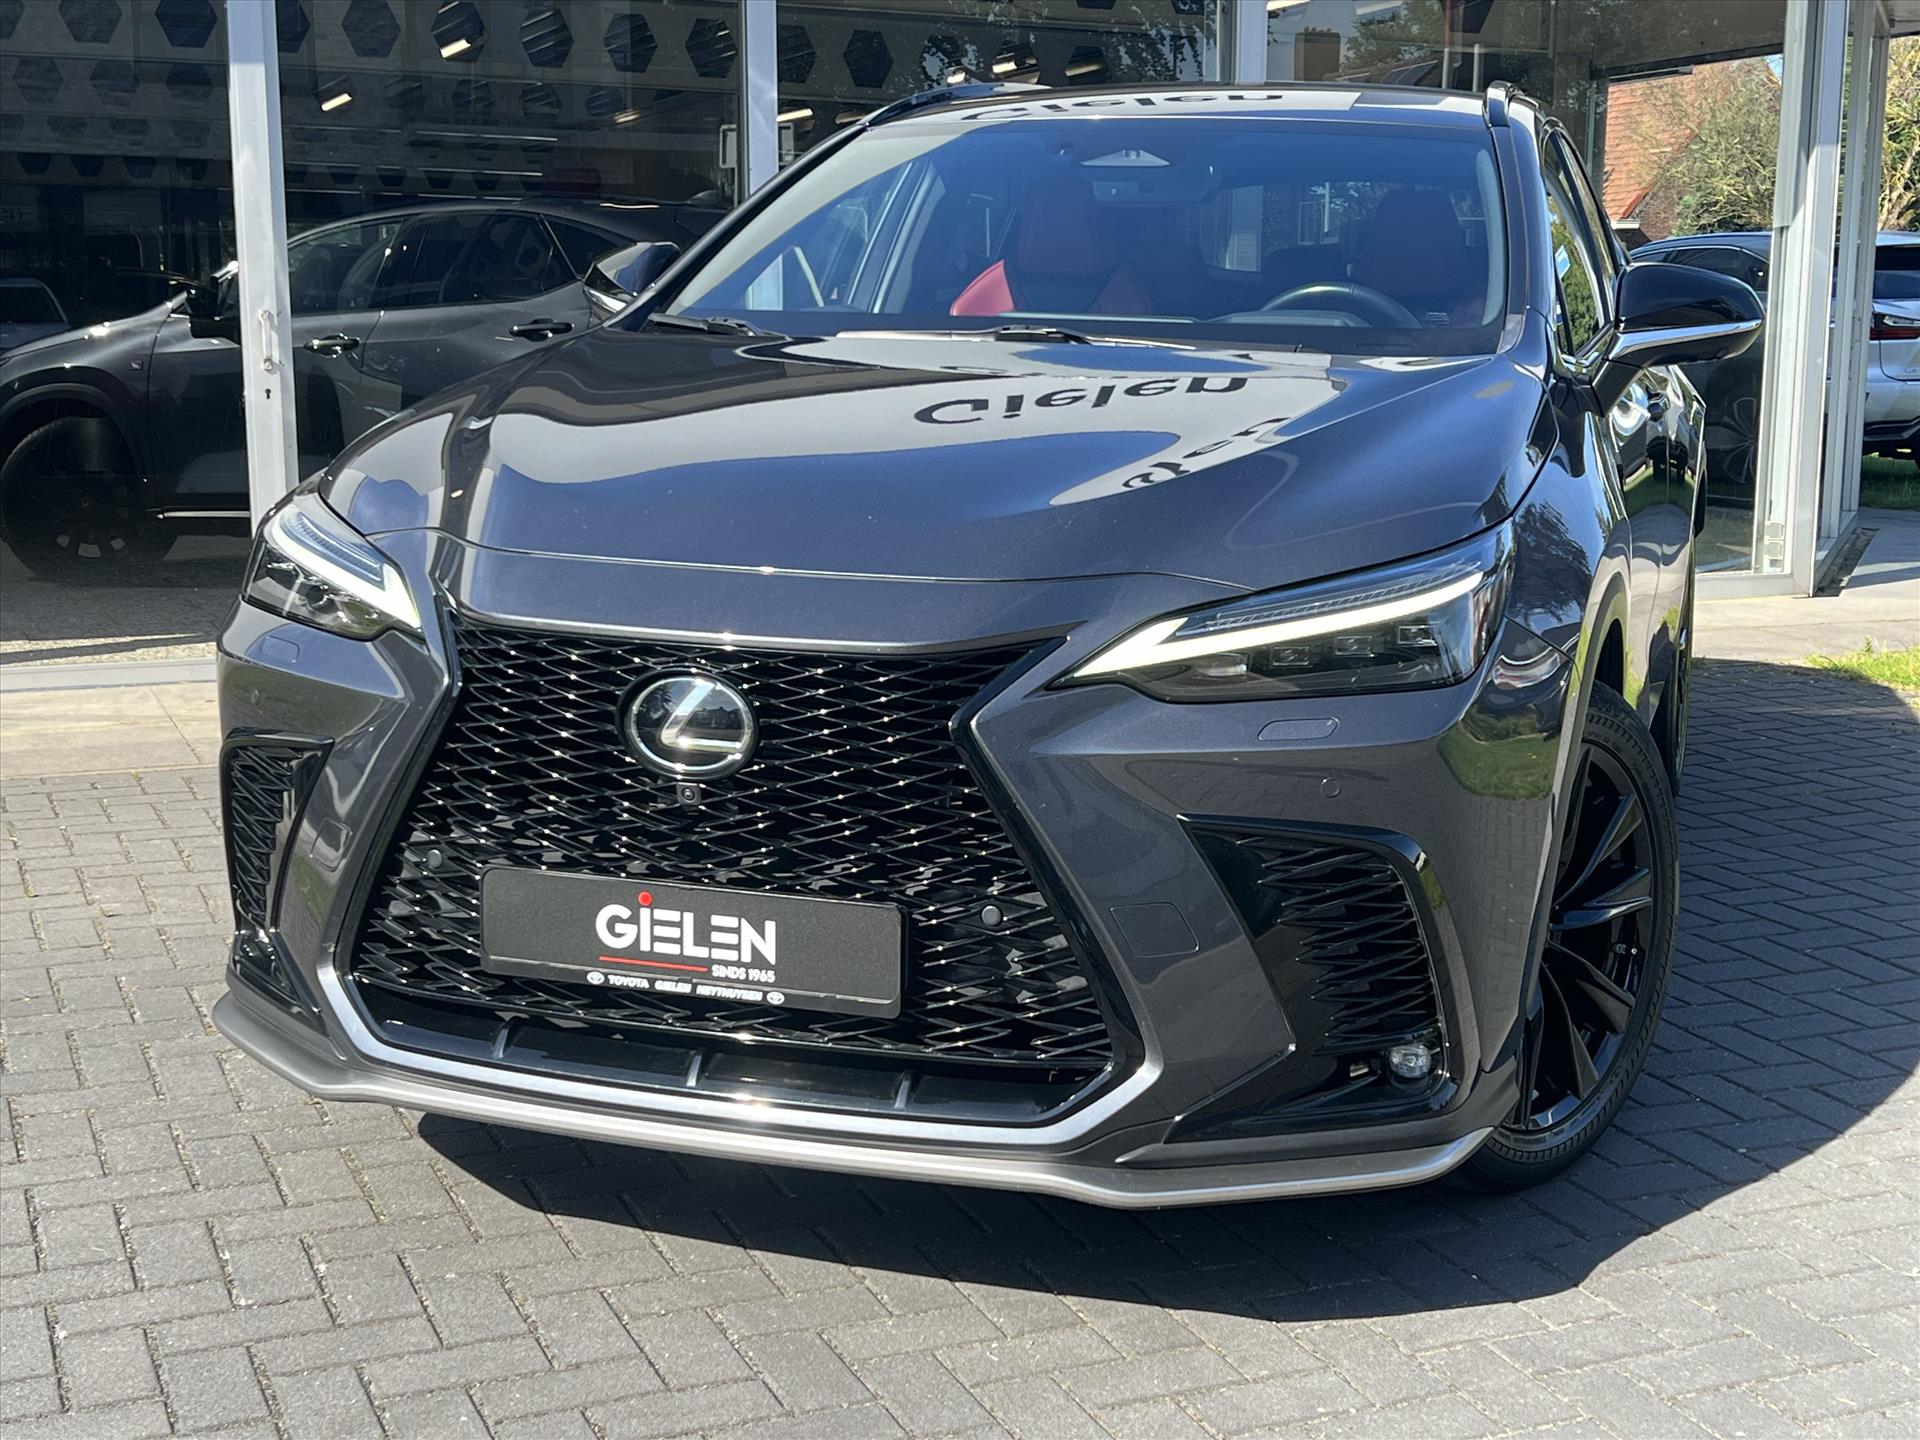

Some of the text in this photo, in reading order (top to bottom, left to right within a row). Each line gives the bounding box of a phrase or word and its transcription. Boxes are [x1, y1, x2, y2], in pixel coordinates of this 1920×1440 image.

[607, 974, 650, 989] TOYOTA
[711, 964, 776, 984] SINDS 1965
